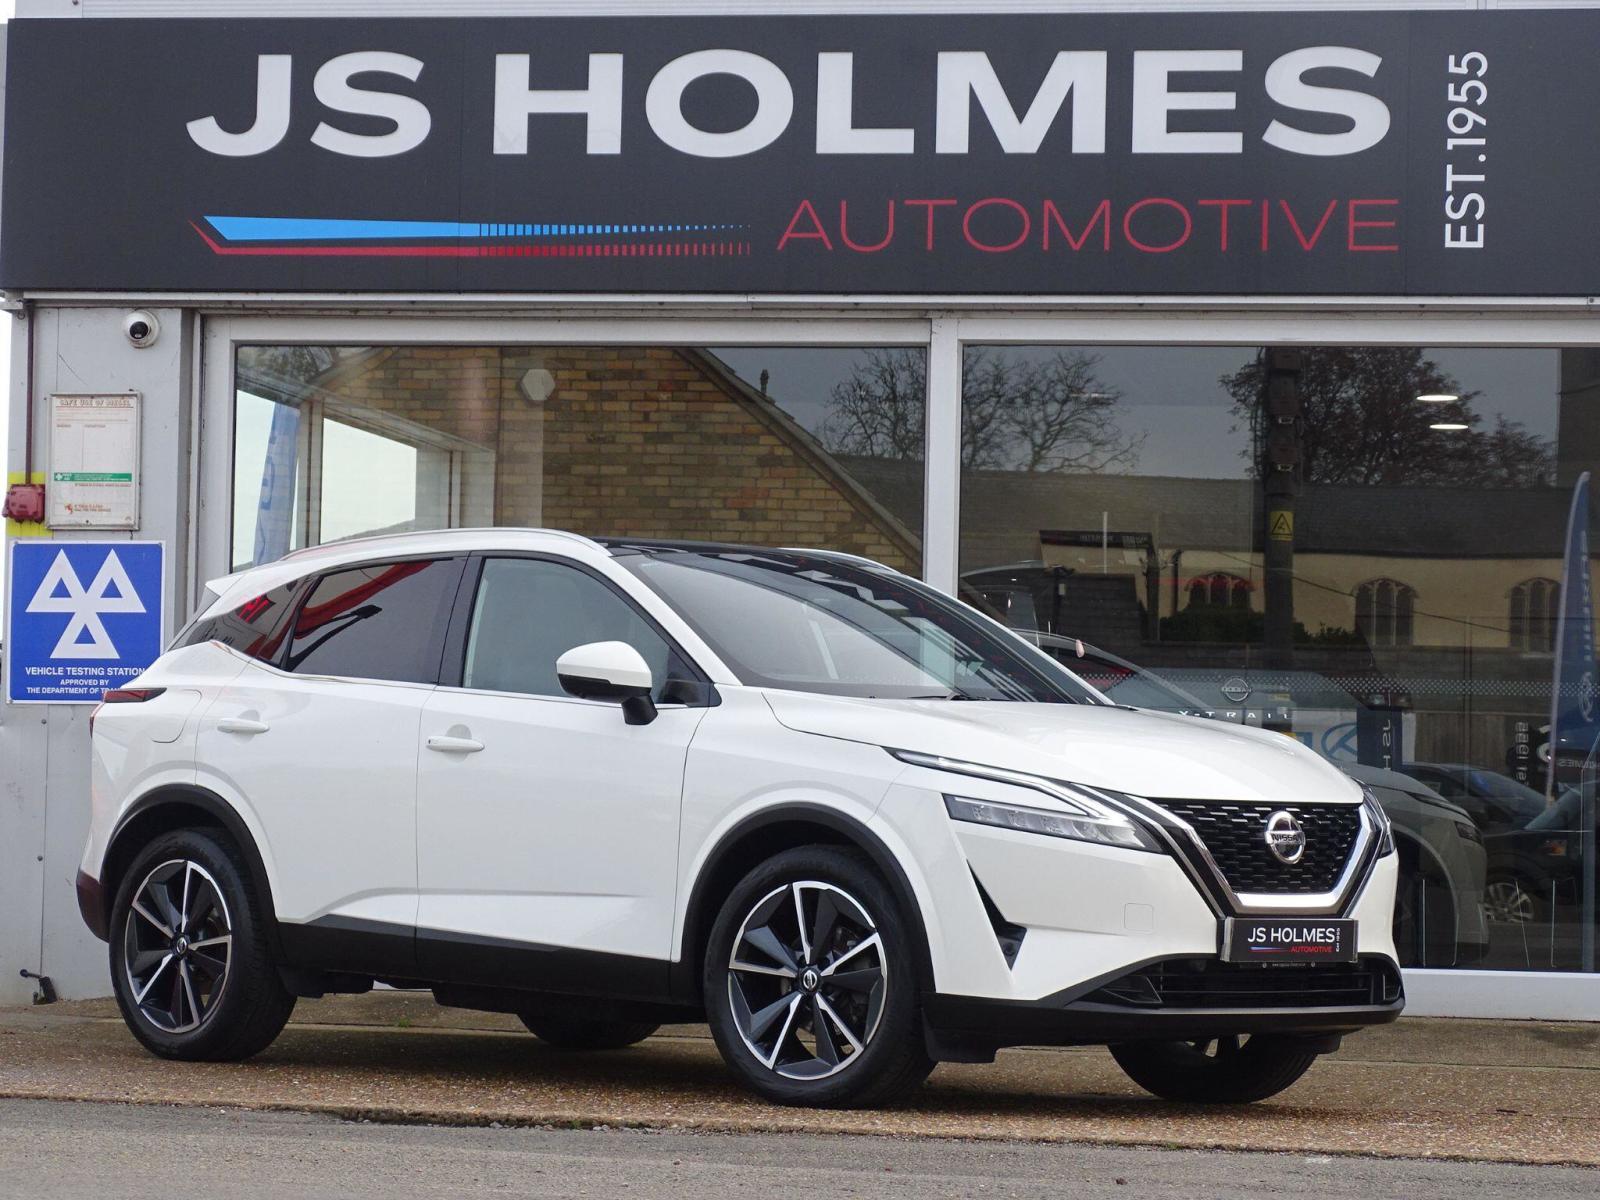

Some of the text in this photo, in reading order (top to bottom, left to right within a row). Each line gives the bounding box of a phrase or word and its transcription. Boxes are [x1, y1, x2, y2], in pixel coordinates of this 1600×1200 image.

[186, 46, 1391, 158] JS HOLMES
[776, 198, 1399, 254] AUTOMOTIVE
[25, 667, 145, 676] VEHICLE TESTING STATION
[42, 687, 88, 695] DEPARTMENT
[1248, 927, 1336, 943] JS HOLMES
